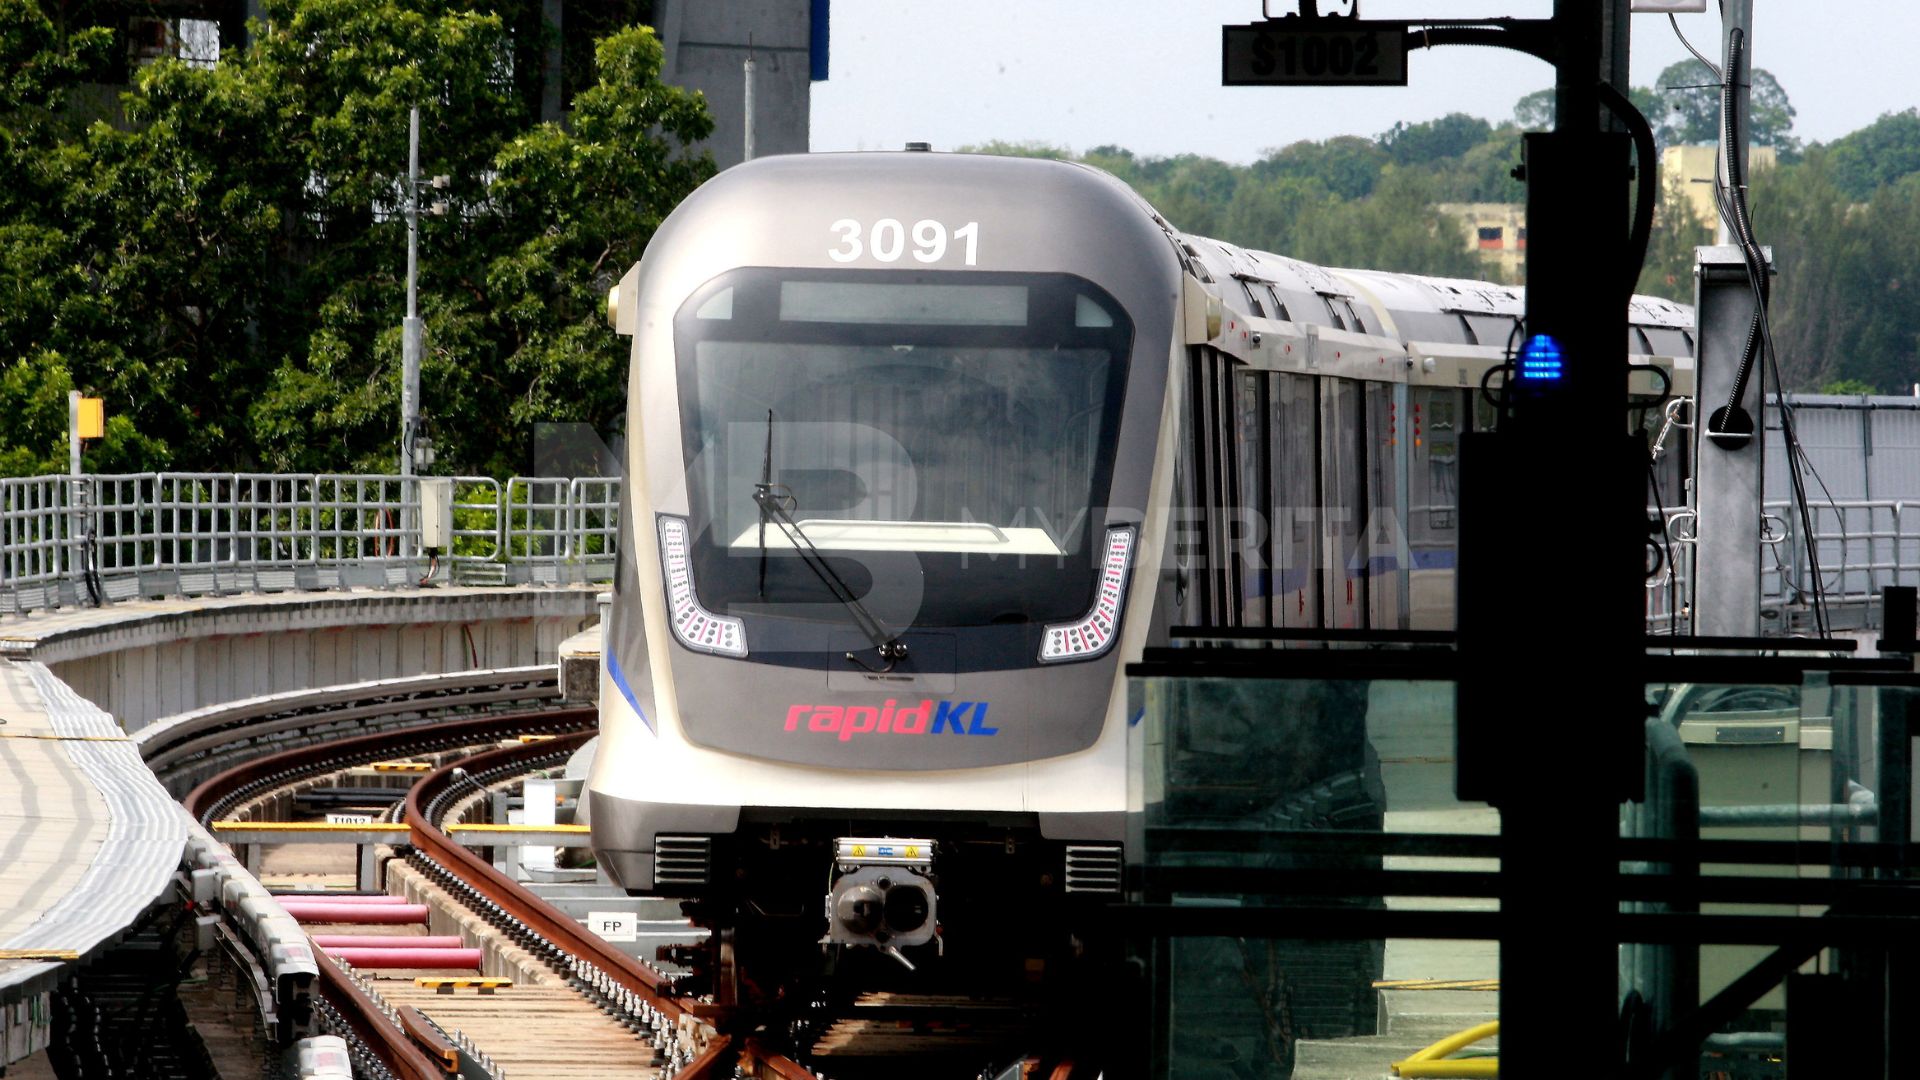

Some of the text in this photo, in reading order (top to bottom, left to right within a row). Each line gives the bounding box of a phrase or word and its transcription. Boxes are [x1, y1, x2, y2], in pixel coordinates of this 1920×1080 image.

[1252, 34, 1379, 76] S1002
[828, 218, 979, 266] 3091
[784, 699, 999, 742] rapidKL
[603, 921, 622, 932] FP
